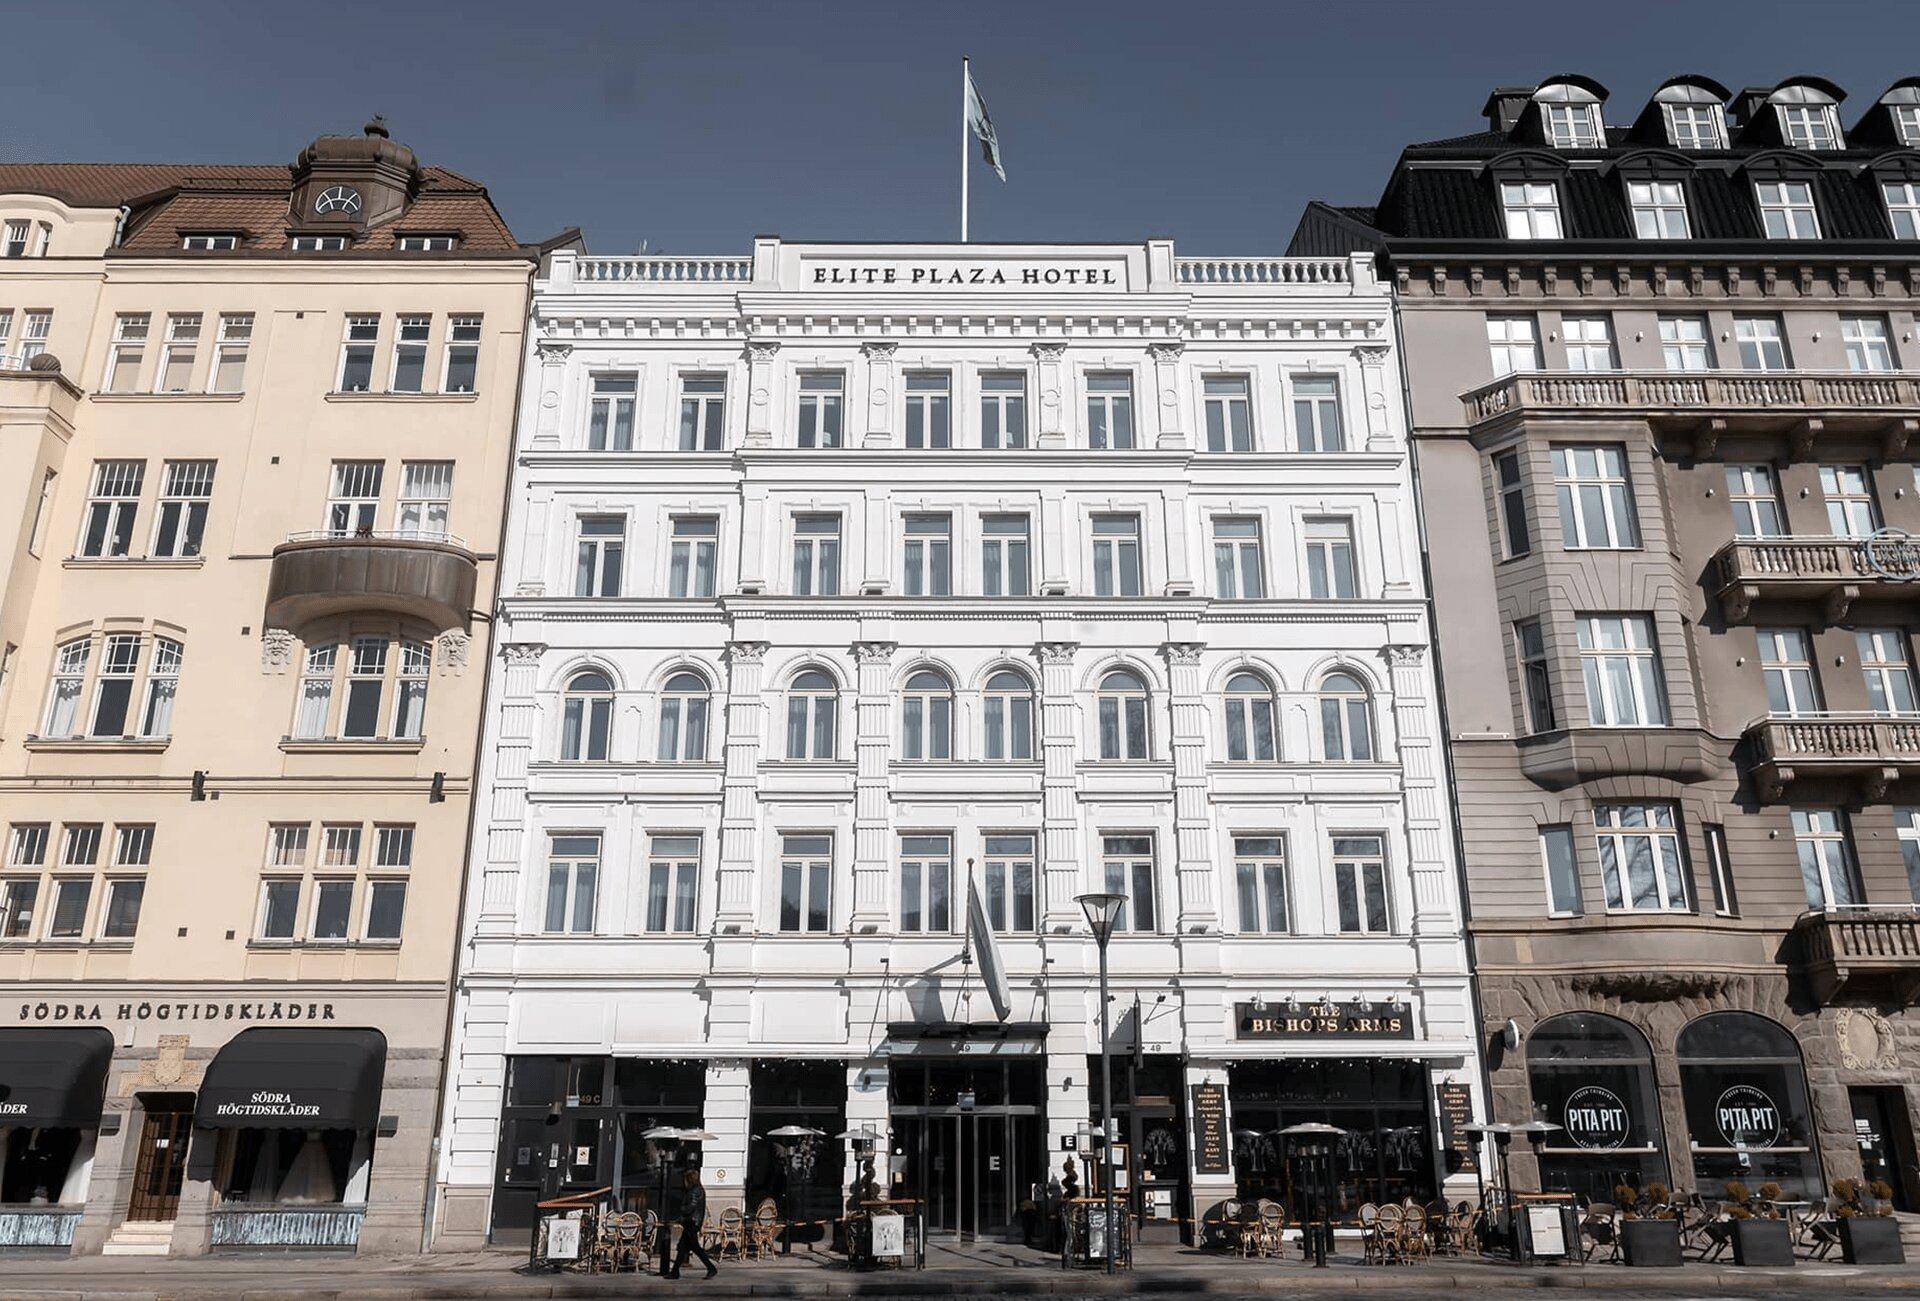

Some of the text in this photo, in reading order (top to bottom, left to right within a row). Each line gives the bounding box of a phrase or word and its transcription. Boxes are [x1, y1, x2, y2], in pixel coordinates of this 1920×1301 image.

[813, 268, 1117, 284] ELITE PLAZA HOTEL
[19, 1002, 336, 1020] SÖDRA HÖGTIDSKLÄDER
[1308, 1006, 1341, 1018] THE
[1252, 1018, 1401, 1032] BISHOPS ARMS
[250, 1091, 291, 1103] SÖDRA
[217, 1103, 320, 1116] HÖGTIDSKLÄDER
[1568, 1108, 1622, 1132] PITA PIT
[1720, 1107, 1773, 1131] PITA PIT
[1065, 1136, 1074, 1147] E
[989, 1156, 1000, 1170] E
